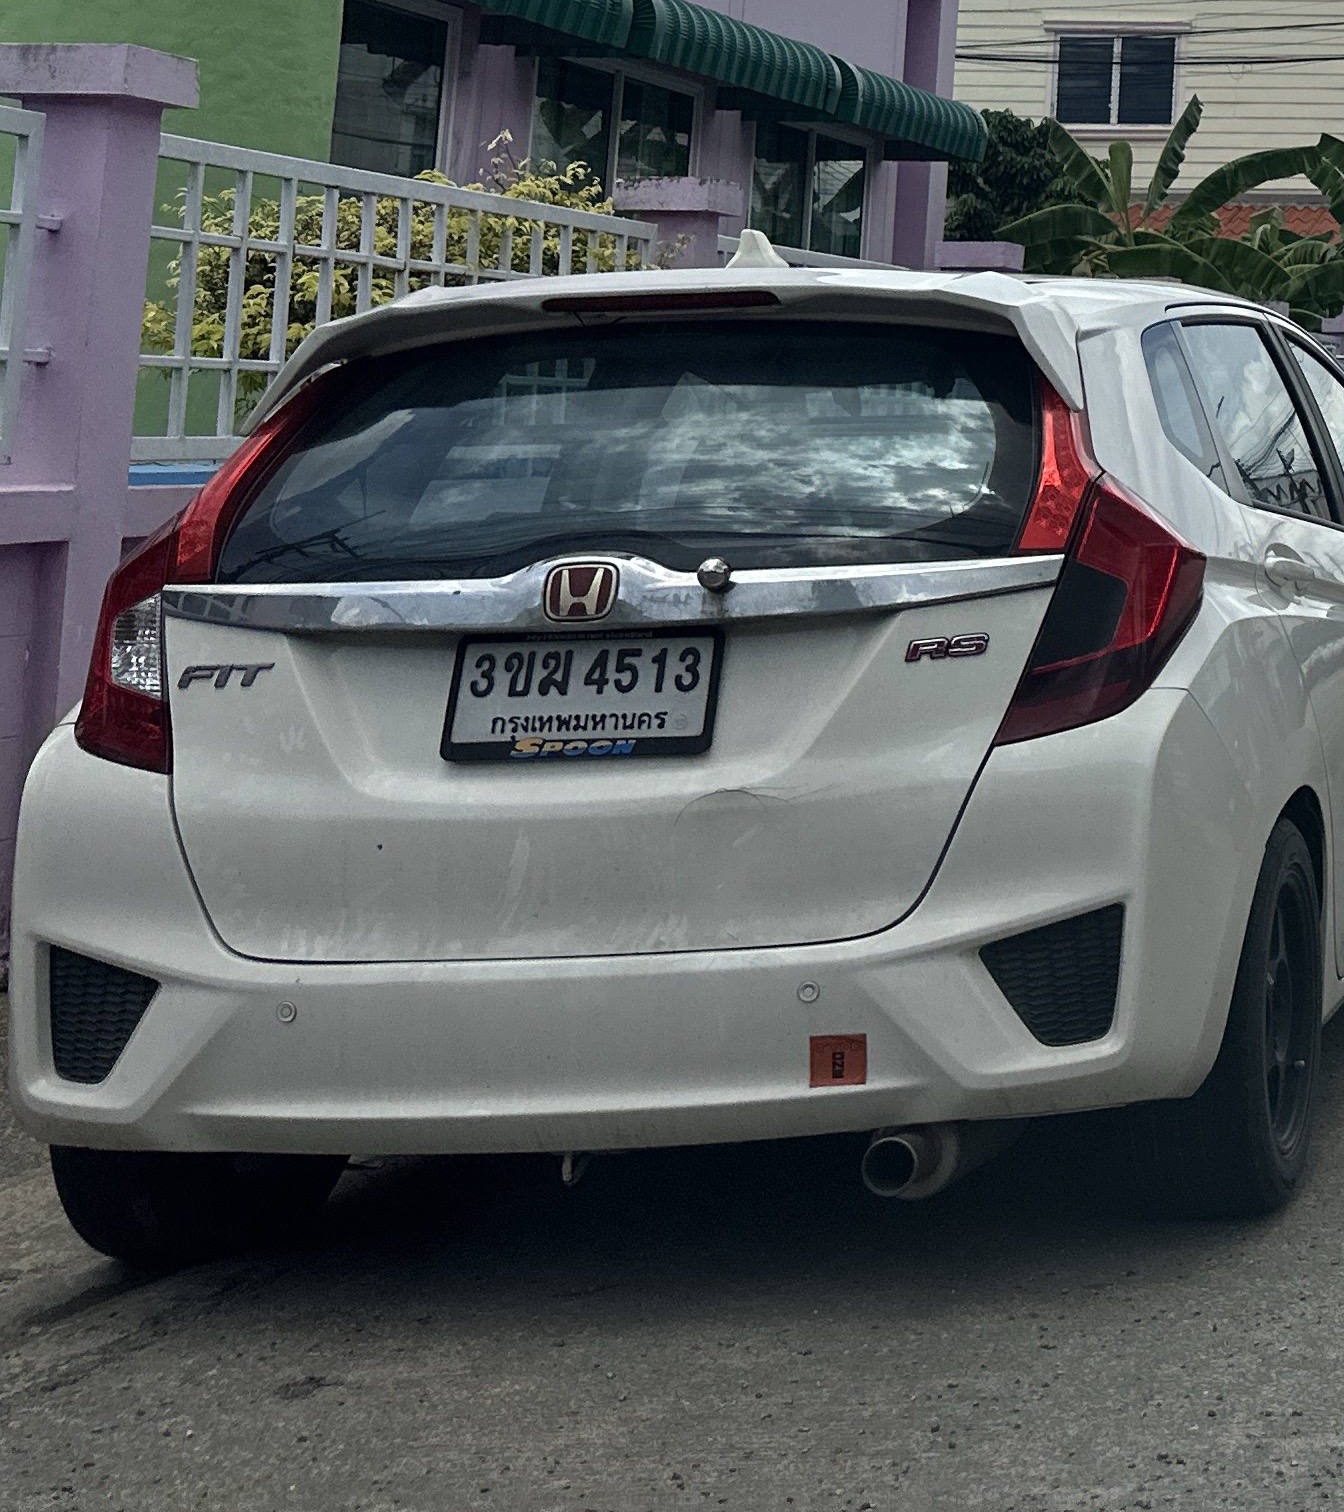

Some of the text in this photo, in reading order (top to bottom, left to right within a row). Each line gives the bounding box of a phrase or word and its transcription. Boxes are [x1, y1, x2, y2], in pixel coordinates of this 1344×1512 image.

[904, 632, 990, 662] RS
[177, 662, 276, 689] FIT
[469, 646, 701, 698] 3ขฆ 4513
[490, 710, 669, 739] กรุงเทพมหานคร
[509, 737, 637, 758] SPOON
